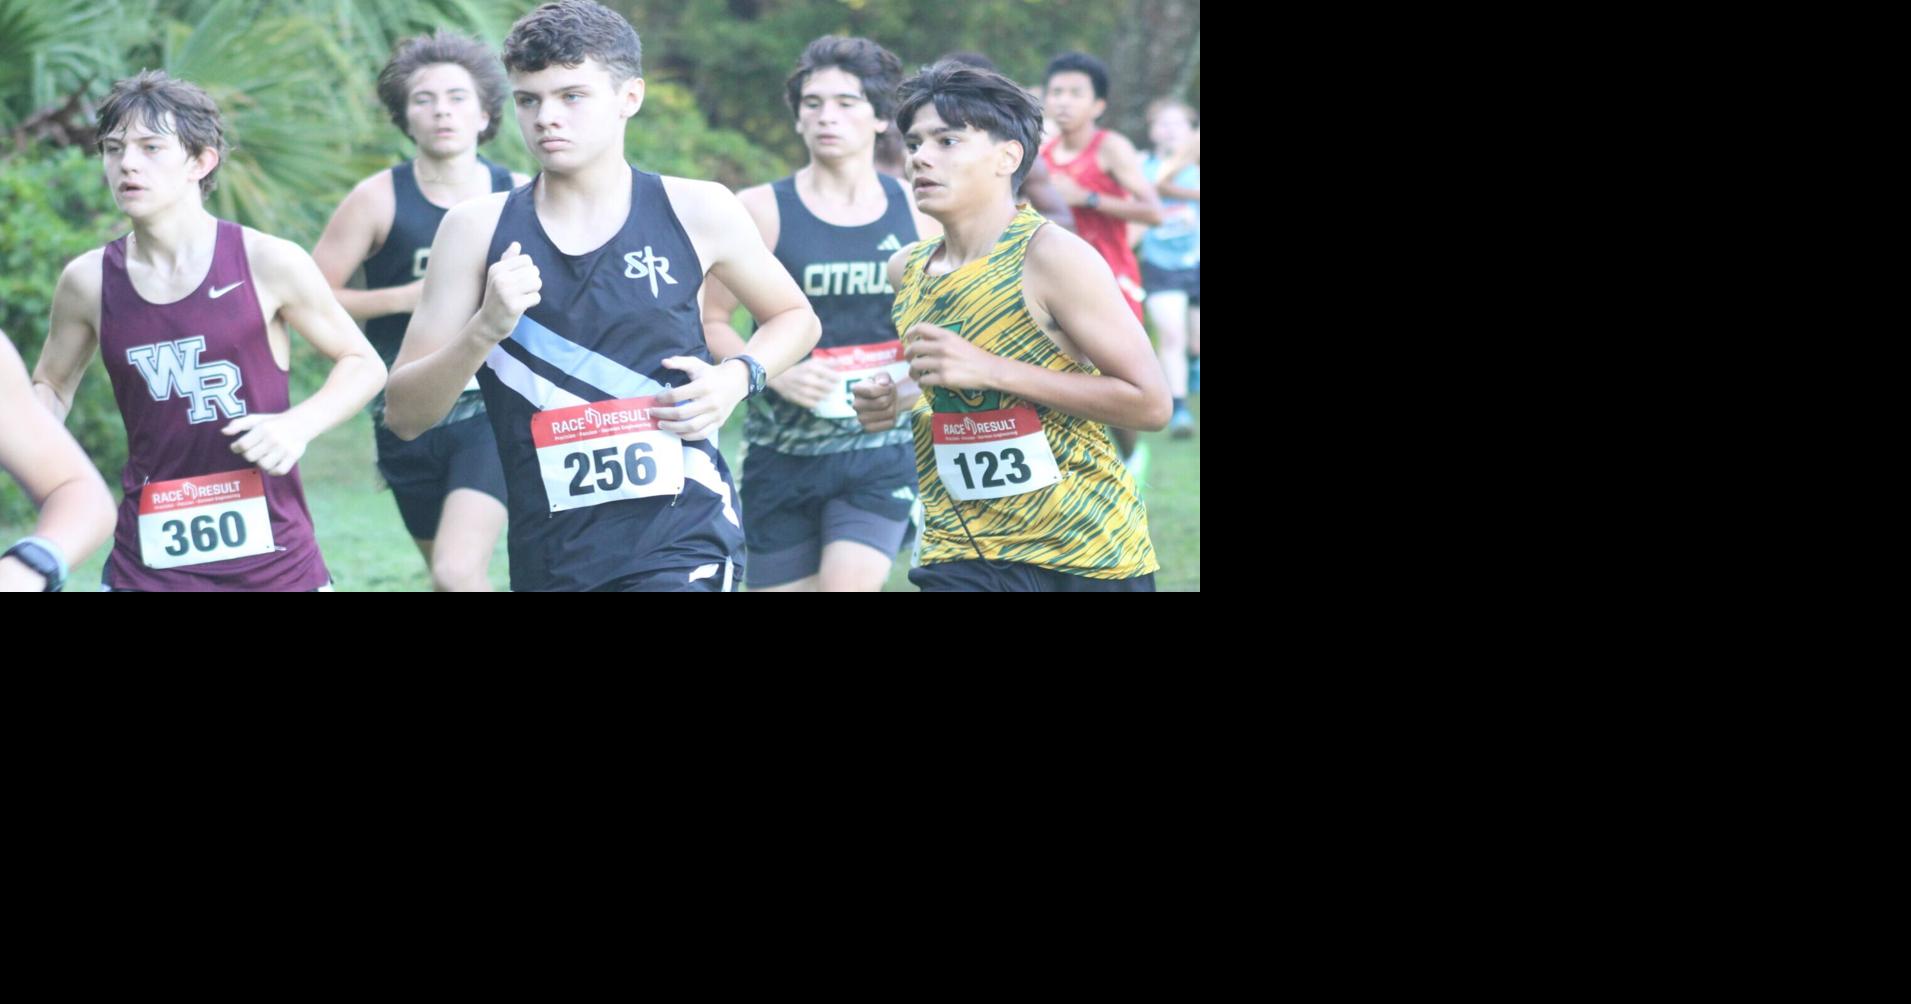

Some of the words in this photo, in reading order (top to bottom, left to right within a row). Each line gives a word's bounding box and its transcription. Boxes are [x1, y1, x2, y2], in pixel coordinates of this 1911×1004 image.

[126, 335, 247, 424] WR
[551, 417, 586, 434] RACE
[602, 407, 651, 425] RESULT
[943, 423, 966, 435] RACE
[976, 418, 1017, 433] RESULT
[563, 441, 658, 497] 256
[953, 447, 1032, 490] 123
[152, 489, 185, 505] RACE
[198, 480, 241, 497] RESULT
[162, 510, 247, 557] 360
